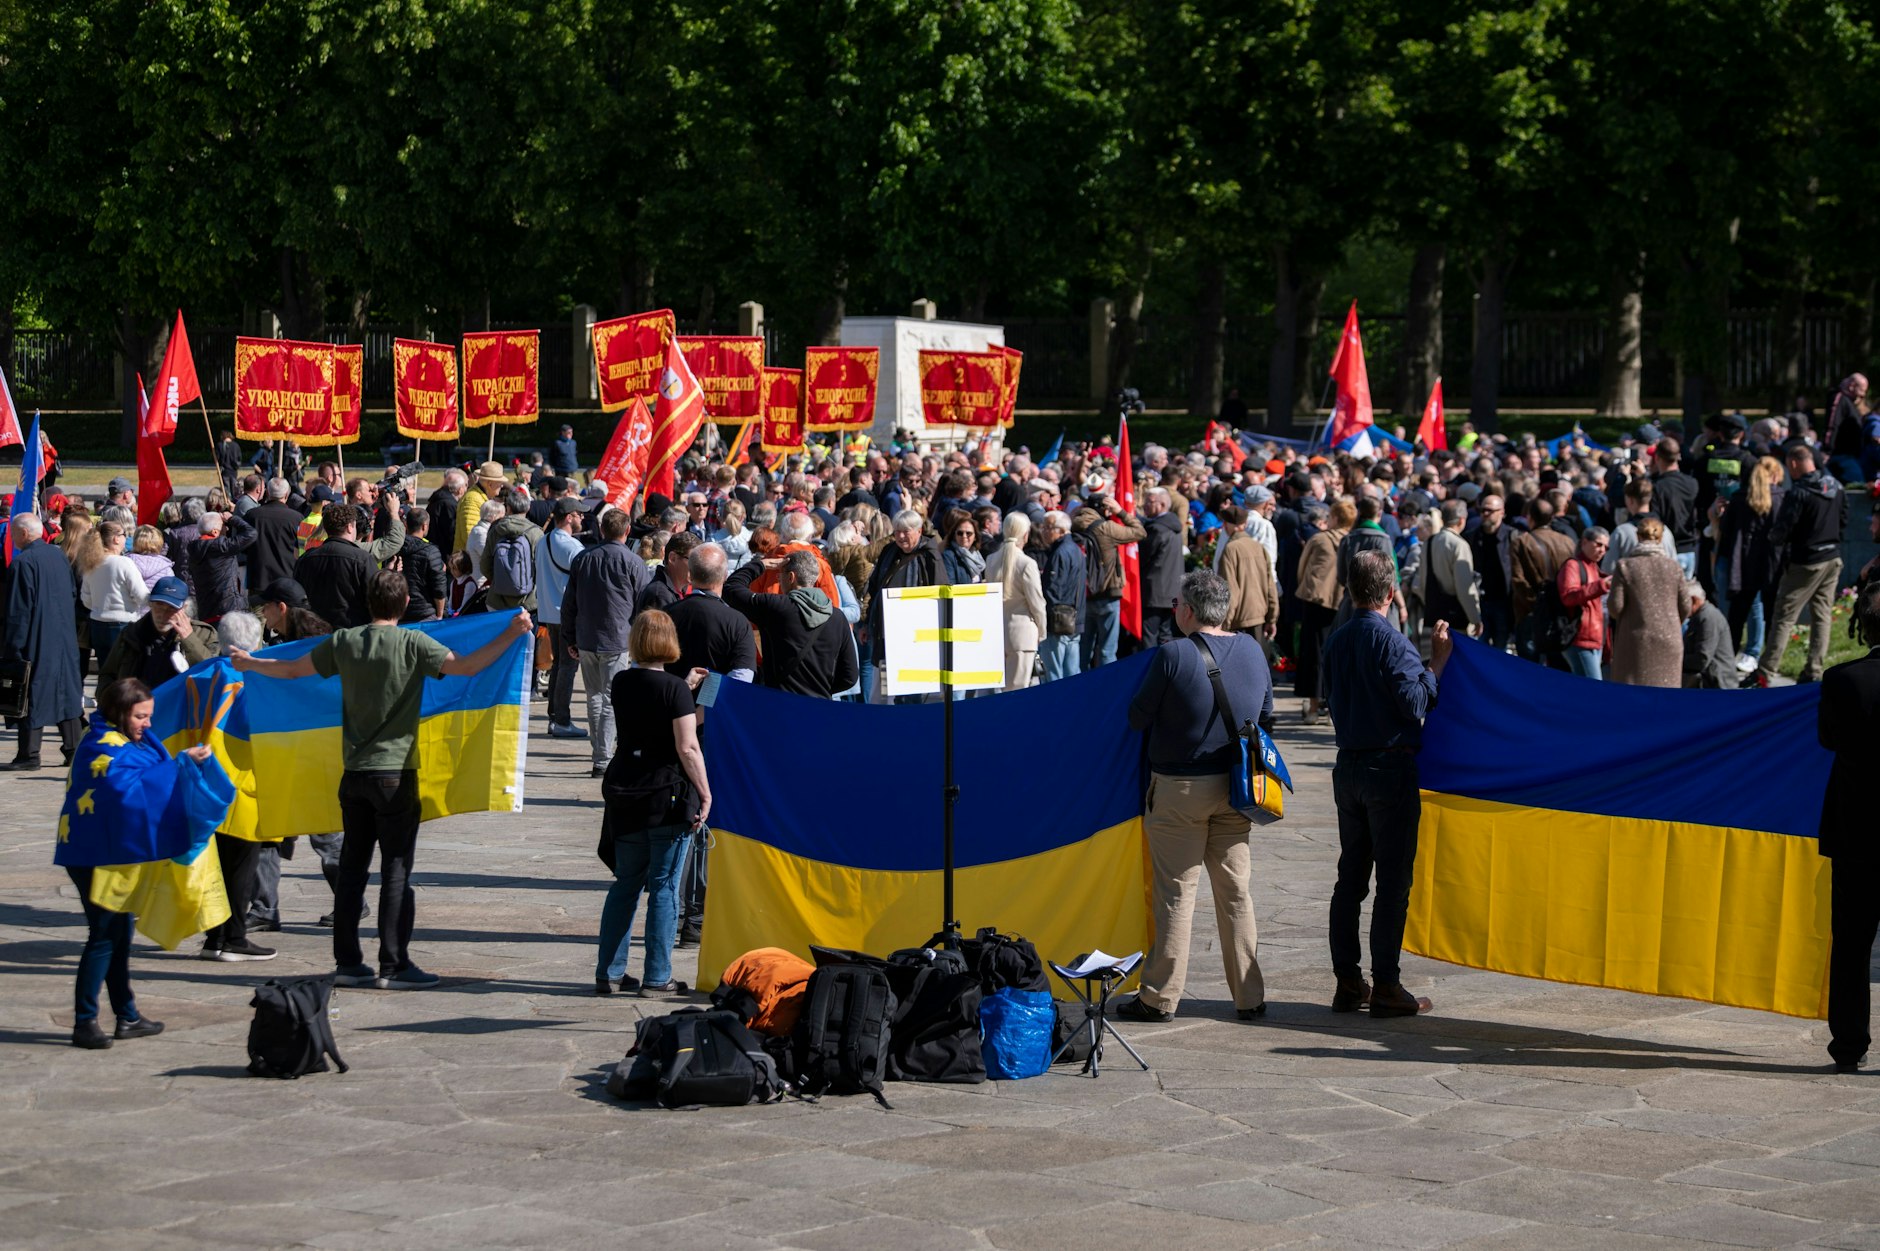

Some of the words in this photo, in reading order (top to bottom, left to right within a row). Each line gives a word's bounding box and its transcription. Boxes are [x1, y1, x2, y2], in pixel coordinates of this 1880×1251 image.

[709, 356, 715, 372] 1
[955, 367, 964, 384] 2
[625, 376, 651, 393] ФРНТ
[247, 388, 325, 411] УКРАНСКИЙ
[267, 407, 305, 428] ФРНТ
